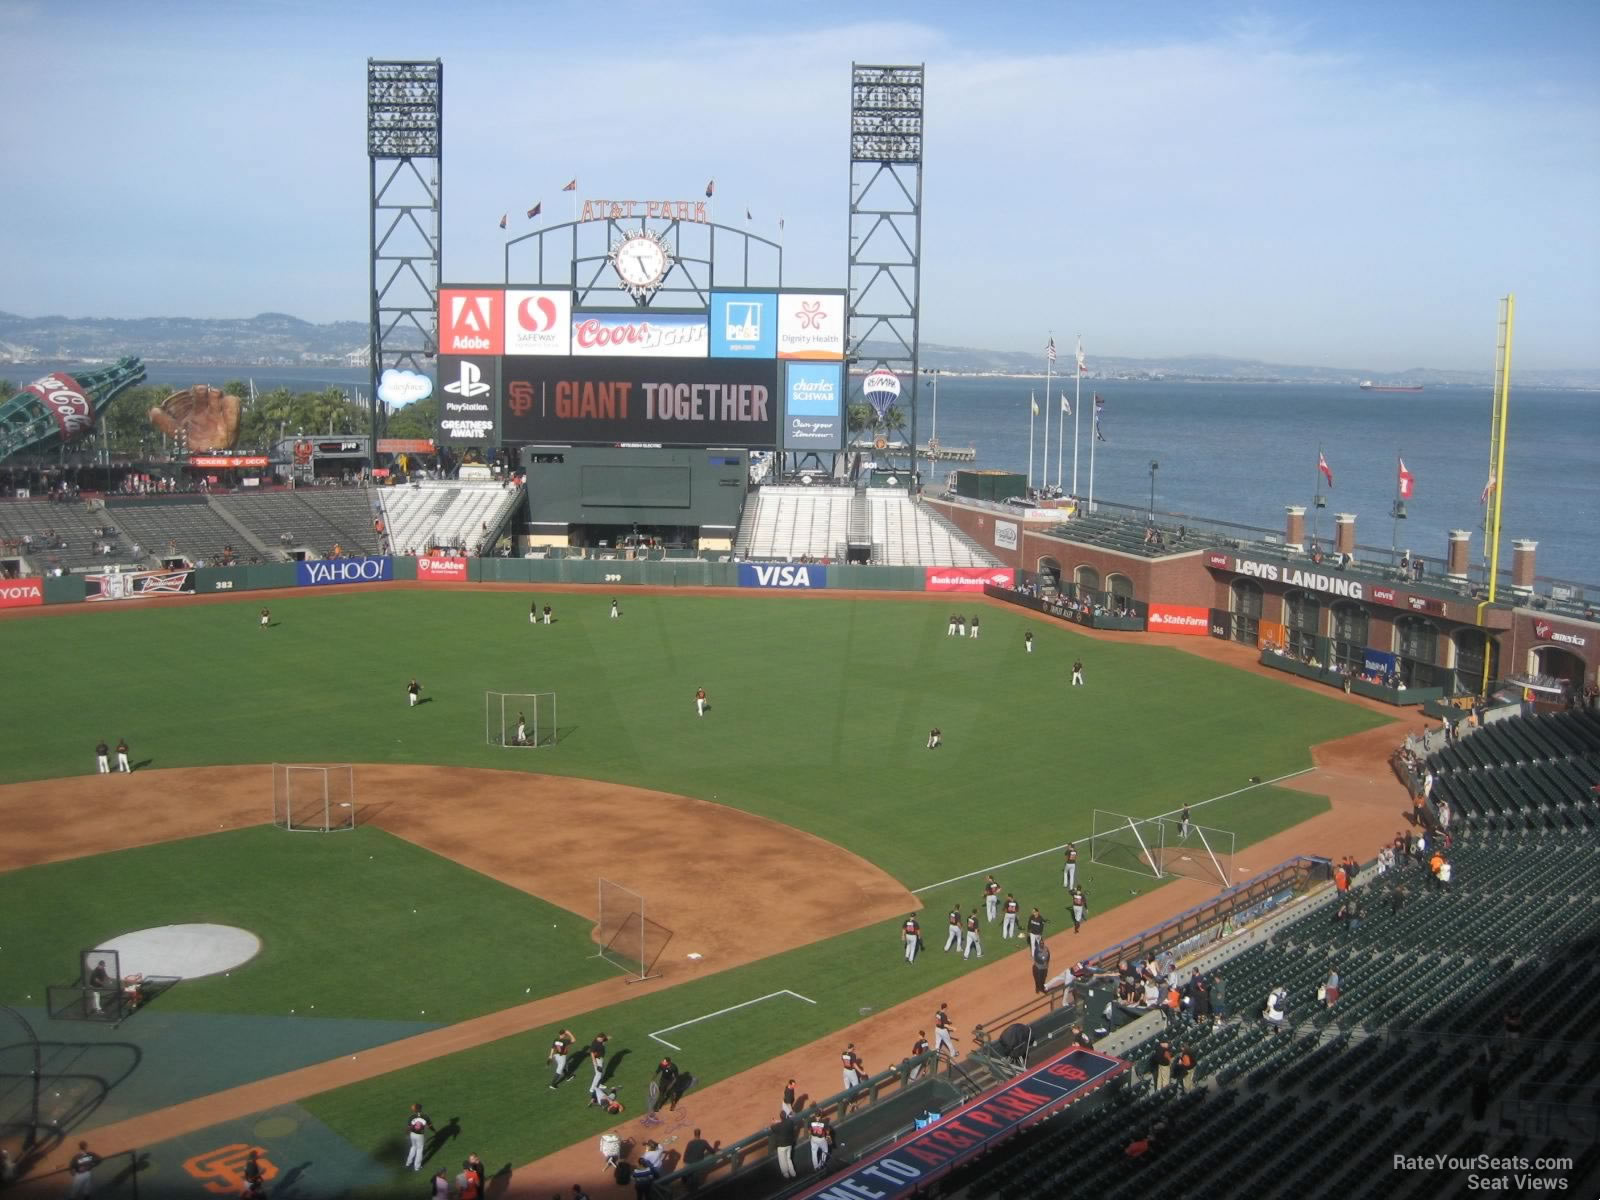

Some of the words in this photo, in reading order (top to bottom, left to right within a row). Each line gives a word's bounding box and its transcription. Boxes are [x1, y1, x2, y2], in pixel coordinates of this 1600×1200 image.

[581, 200, 637, 223] AT&T
[646, 200, 708, 224] PARK
[517, 333, 556, 342] SAFEWAY
[575, 318, 648, 349] Coors
[782, 334, 811, 345] Dignity
[812, 334, 839, 344] Health
[453, 335, 491, 350] Adobe
[793, 378, 834, 391] charles
[555, 380, 633, 419] GIANT
[641, 382, 769, 422] TOGETHER
[793, 392, 834, 401] SCHWAB
[441, 420, 493, 430] GREATNESS
[305, 559, 384, 584] YAHOO!
[431, 560, 465, 570] McAfee
[605, 574, 622, 582] 399
[751, 565, 811, 587] VISA
[931, 575, 951, 585] Bank
[960, 576, 991, 585] America
[1282, 567, 1363, 600] LANDING
[1212, 625, 1224, 635] 365
[861, 1158, 921, 1185] TO
[904, 1119, 988, 1166] AT&T
[971, 1086, 1053, 1132] PARK
